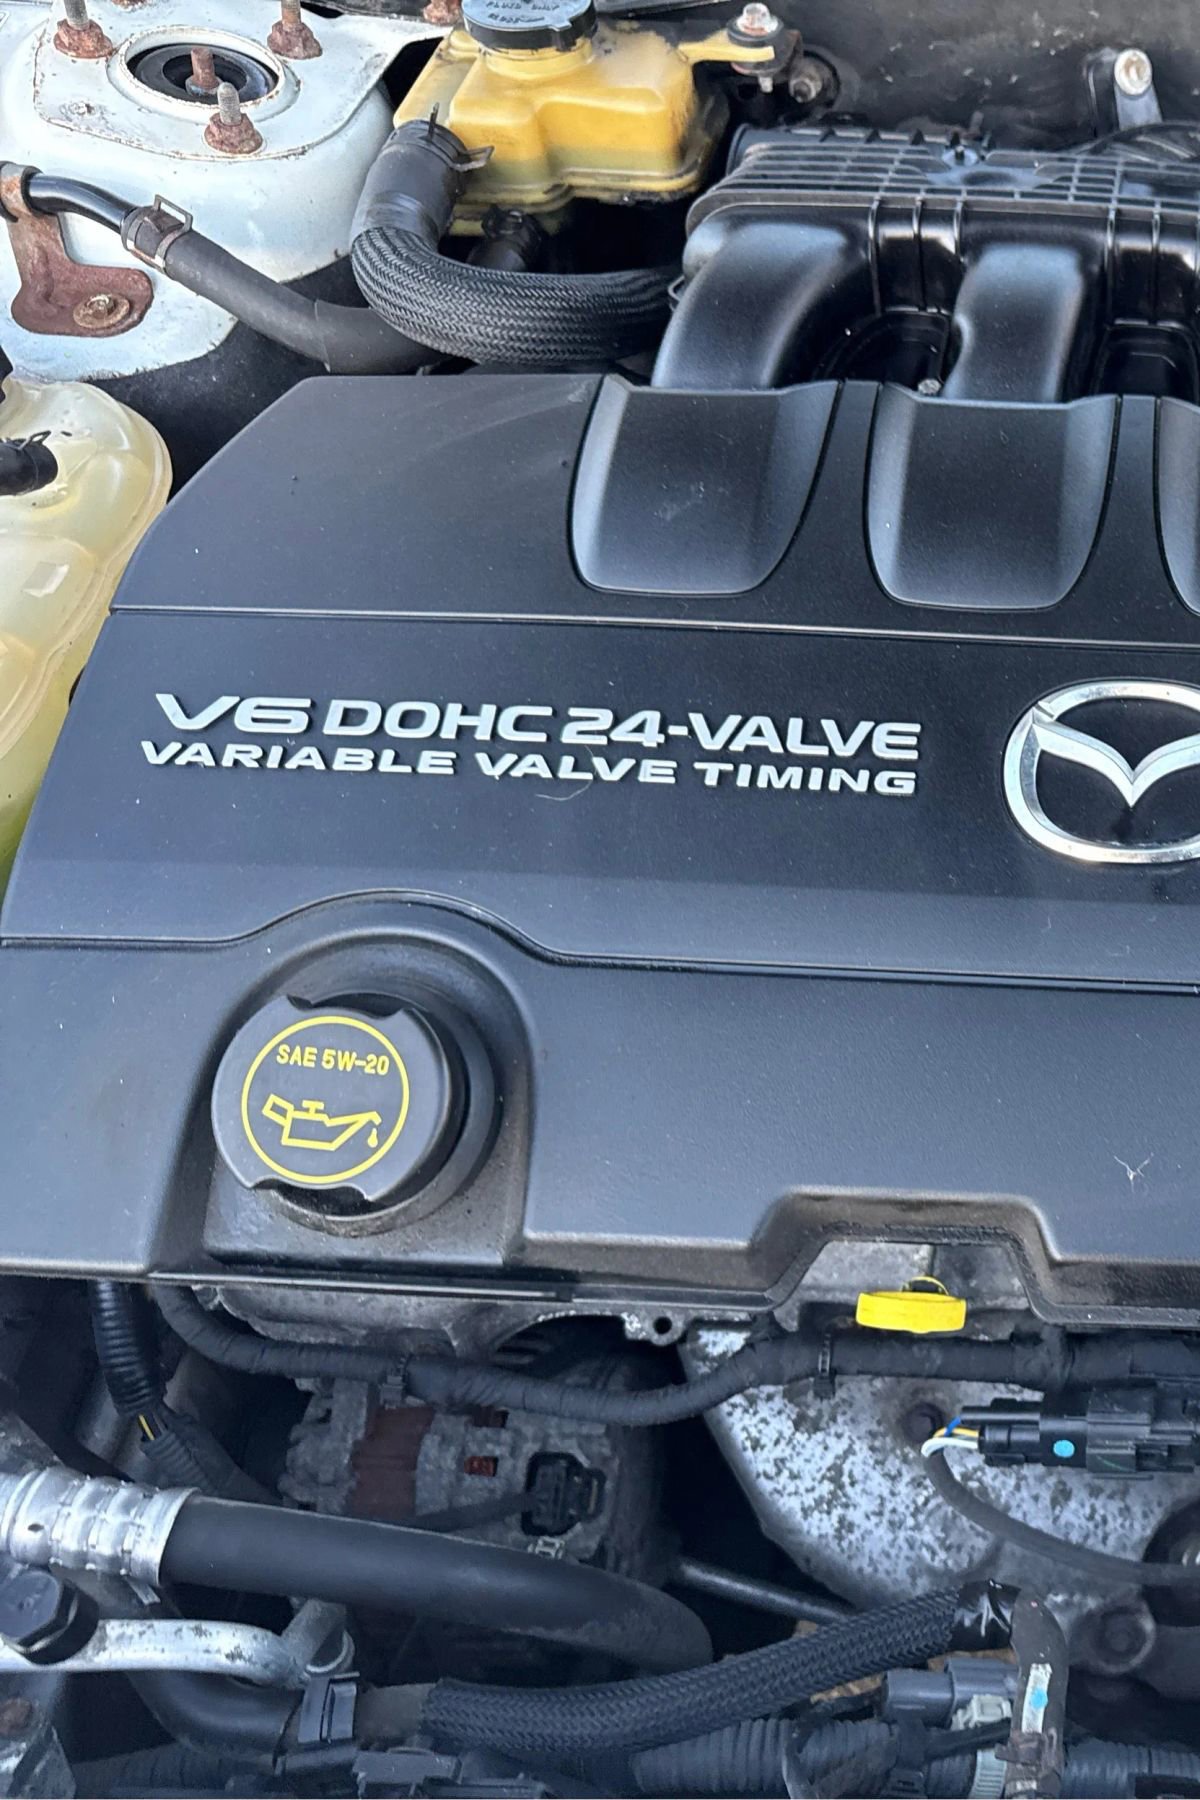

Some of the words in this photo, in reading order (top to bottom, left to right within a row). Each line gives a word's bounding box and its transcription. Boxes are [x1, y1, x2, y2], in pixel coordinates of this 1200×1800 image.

[155, 693, 312, 734] V6
[322, 699, 553, 743] DOHC
[560, 707, 922, 760] 24-VALVE
[141, 740, 458, 775] VARIABLE
[475, 752, 678, 785] VALVE
[693, 761, 917, 796] TIMING
[276, 1044, 318, 1068] SAE
[321, 1048, 390, 1076] 5W-20
